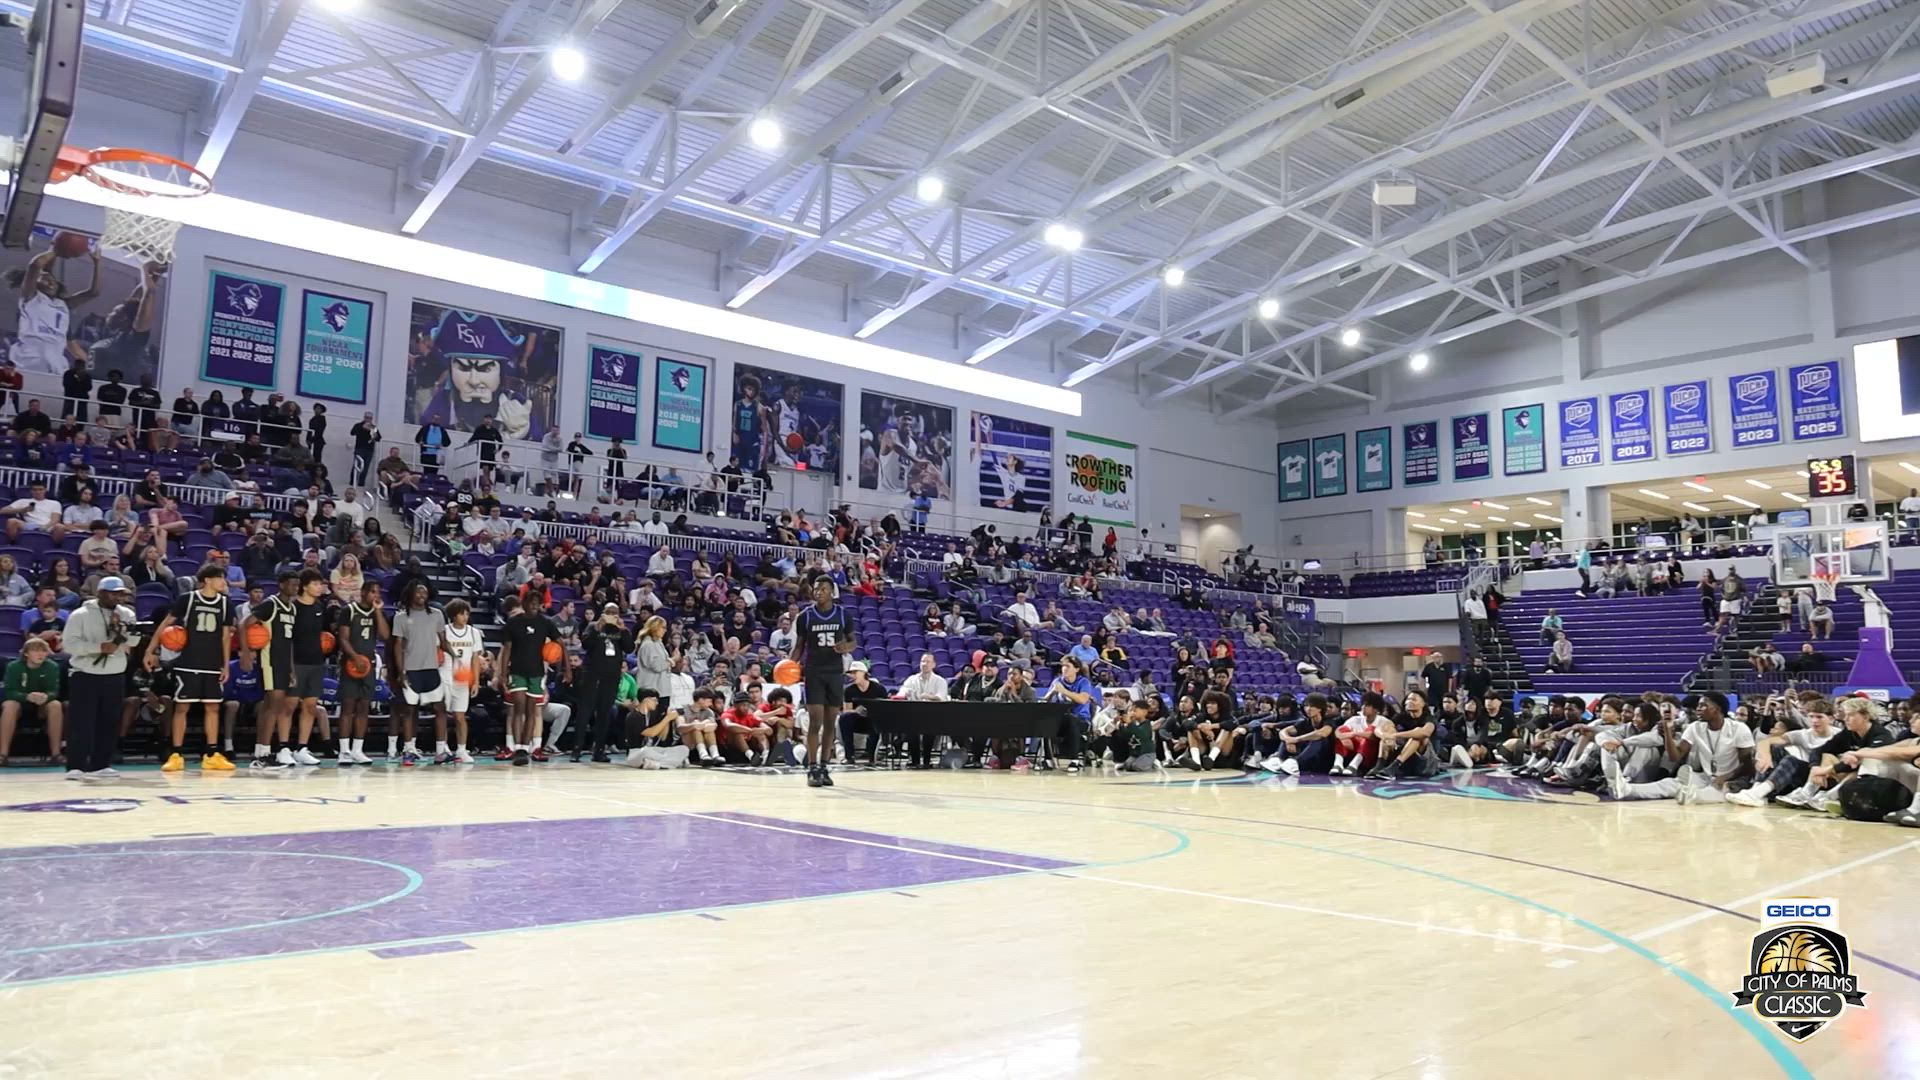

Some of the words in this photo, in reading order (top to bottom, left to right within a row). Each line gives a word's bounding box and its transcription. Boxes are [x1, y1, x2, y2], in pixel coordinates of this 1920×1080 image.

[456, 323, 485, 349] FSW
[335, 357, 364, 370] 2020
[223, 422, 241, 433] 116
[1799, 421, 1837, 436] 2025
[1738, 428, 1774, 443] 2023
[1671, 437, 1705, 451] 2022
[1616, 445, 1647, 458] 2021
[1566, 453, 1594, 465] 2017
[1065, 454, 1133, 480] CROWTHER
[1070, 472, 1127, 494] ROOFING
[1818, 471, 1847, 494] 35
[361, 626, 371, 640] 4
[811, 624, 840, 632] BARTLETT
[817, 632, 836, 647] 35
